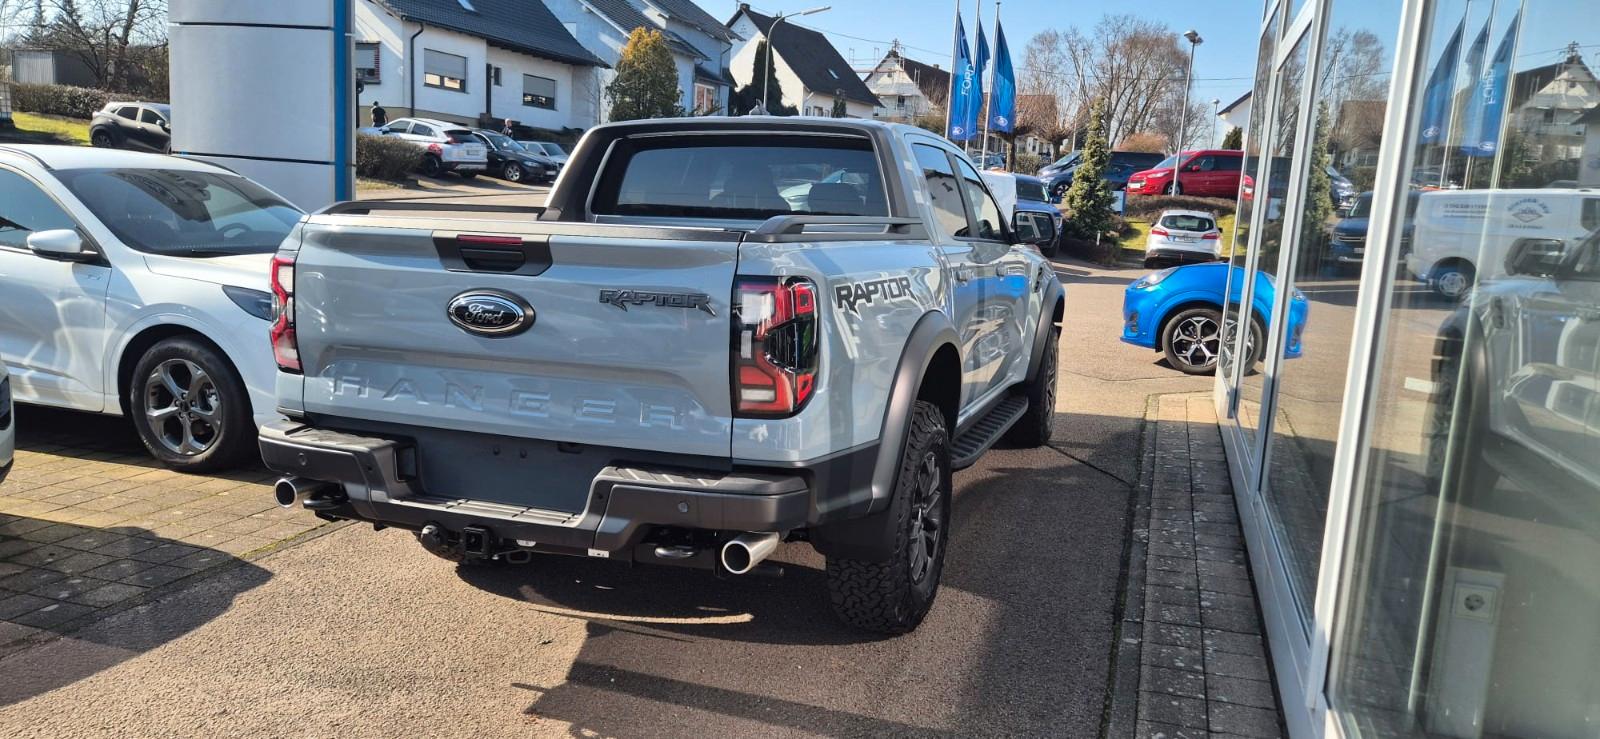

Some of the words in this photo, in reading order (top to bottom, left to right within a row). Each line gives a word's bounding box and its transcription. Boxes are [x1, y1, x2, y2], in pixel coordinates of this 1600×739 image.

[600, 288, 716, 317] RAPTOR
[835, 276, 921, 317] RAPTOR
[464, 303, 504, 325] Ford
